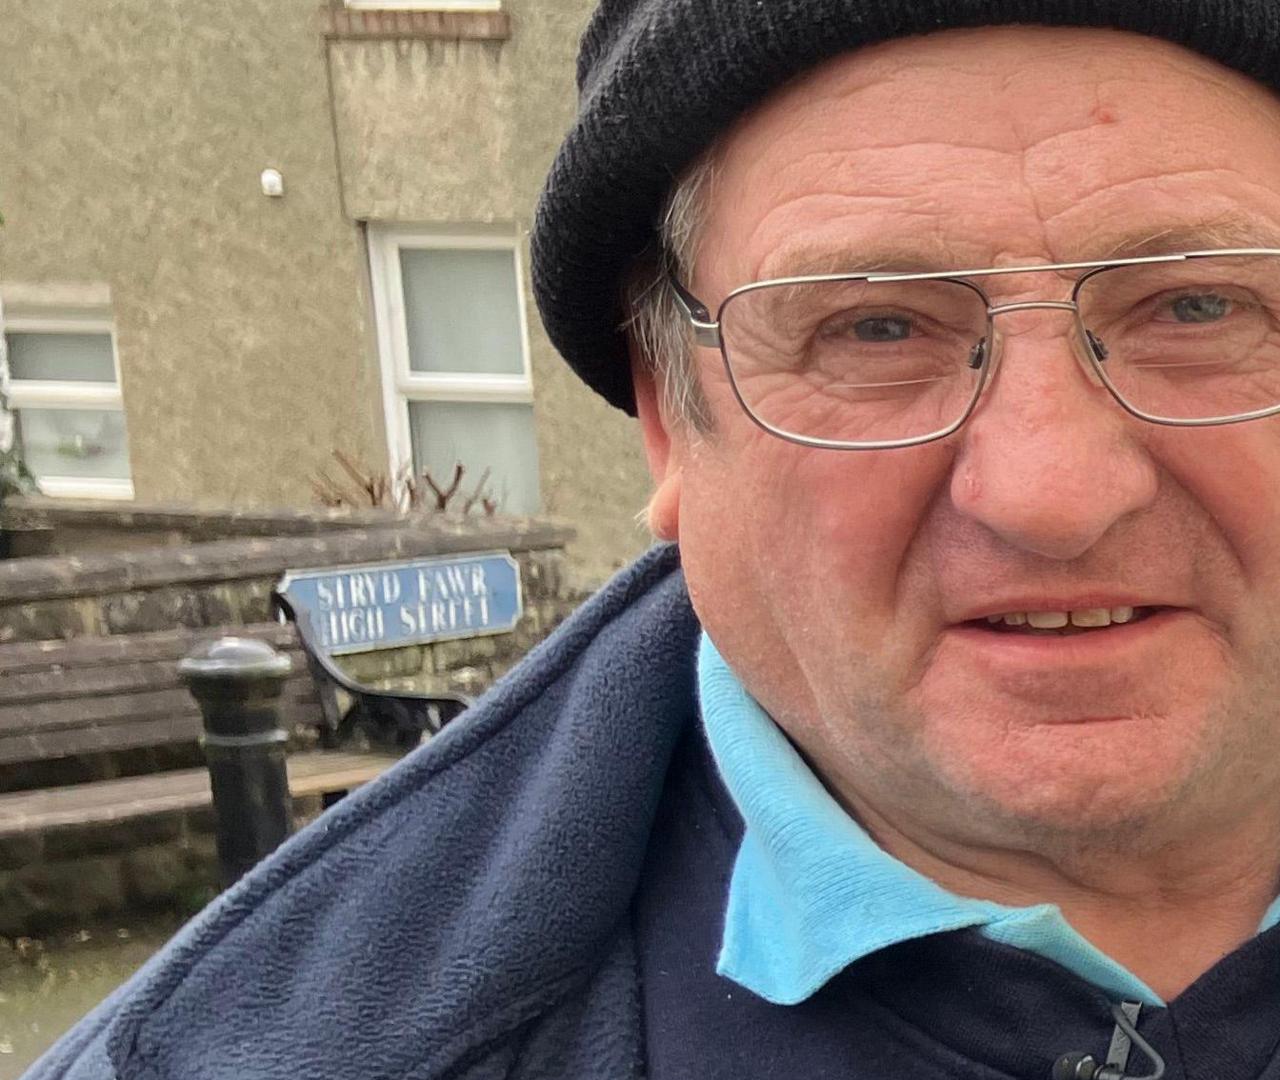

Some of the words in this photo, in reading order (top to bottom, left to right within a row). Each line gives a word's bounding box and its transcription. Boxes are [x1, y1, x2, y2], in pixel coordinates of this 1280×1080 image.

[317, 572, 400, 611] STRYD
[418, 565, 488, 601] FAWR
[320, 606, 384, 645] HIGH
[400, 597, 488, 635] STREET
